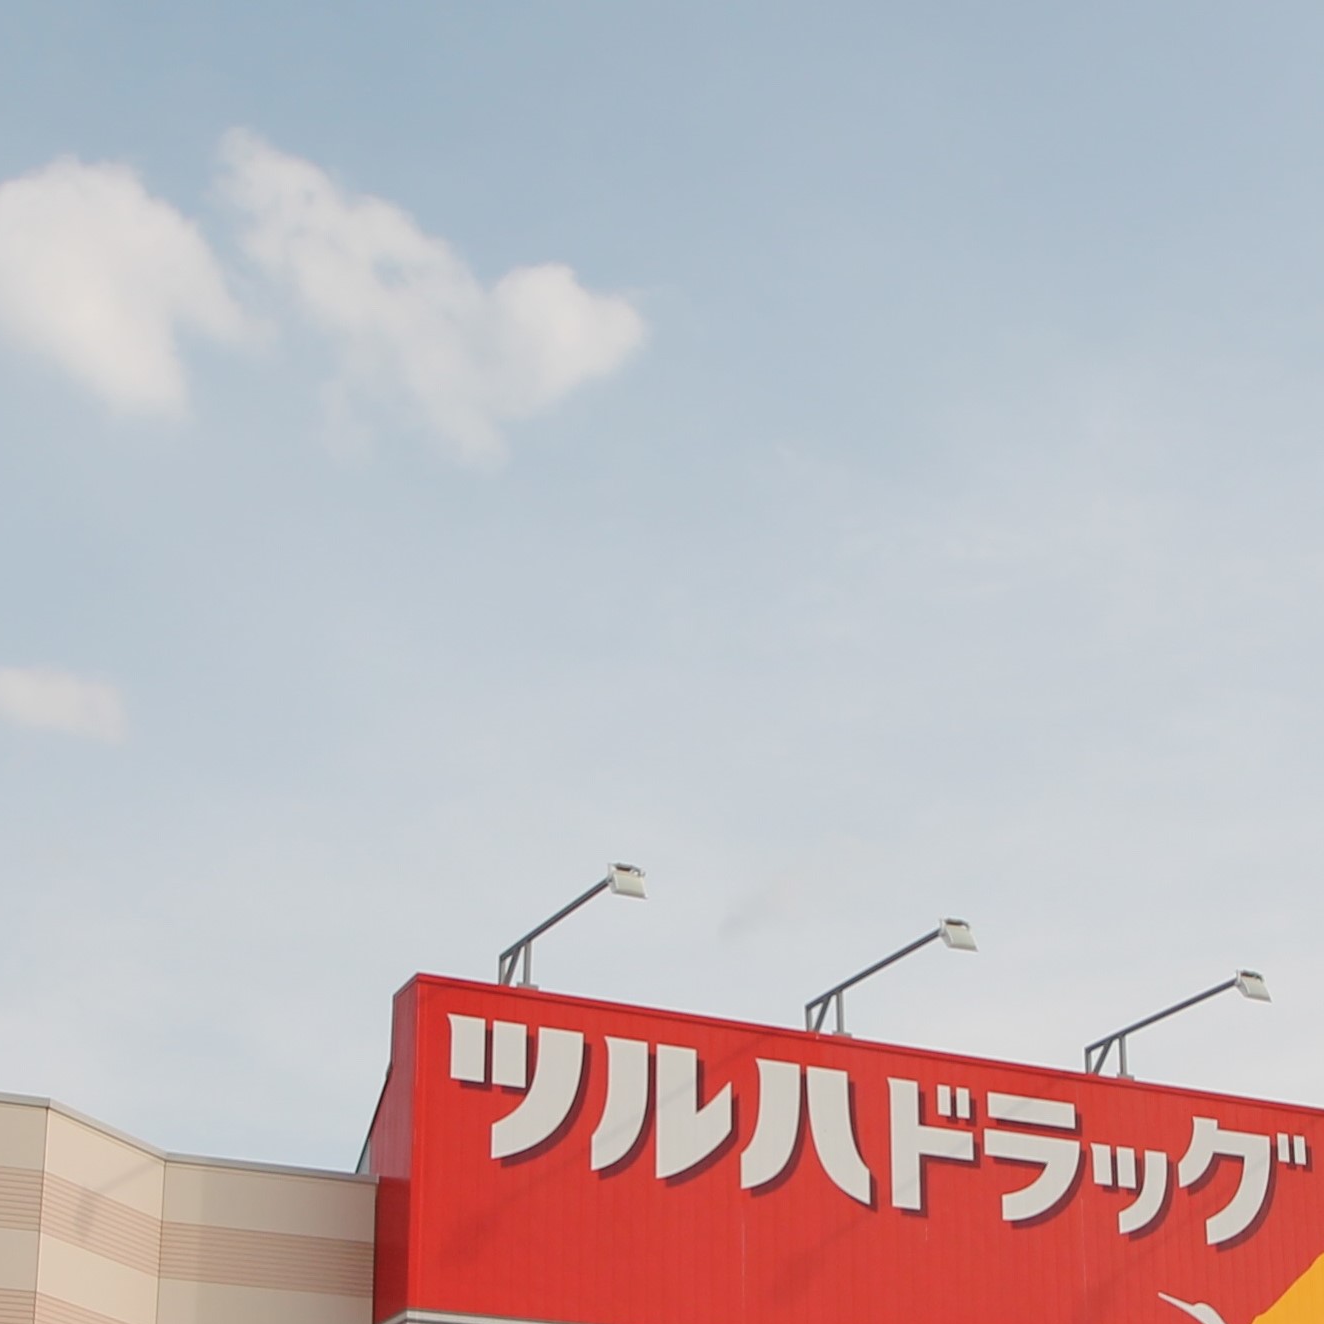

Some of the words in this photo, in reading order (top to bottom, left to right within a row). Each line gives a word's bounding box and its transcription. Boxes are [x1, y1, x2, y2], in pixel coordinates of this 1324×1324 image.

[448, 1012, 1307, 1246] ツルハドラッグ
